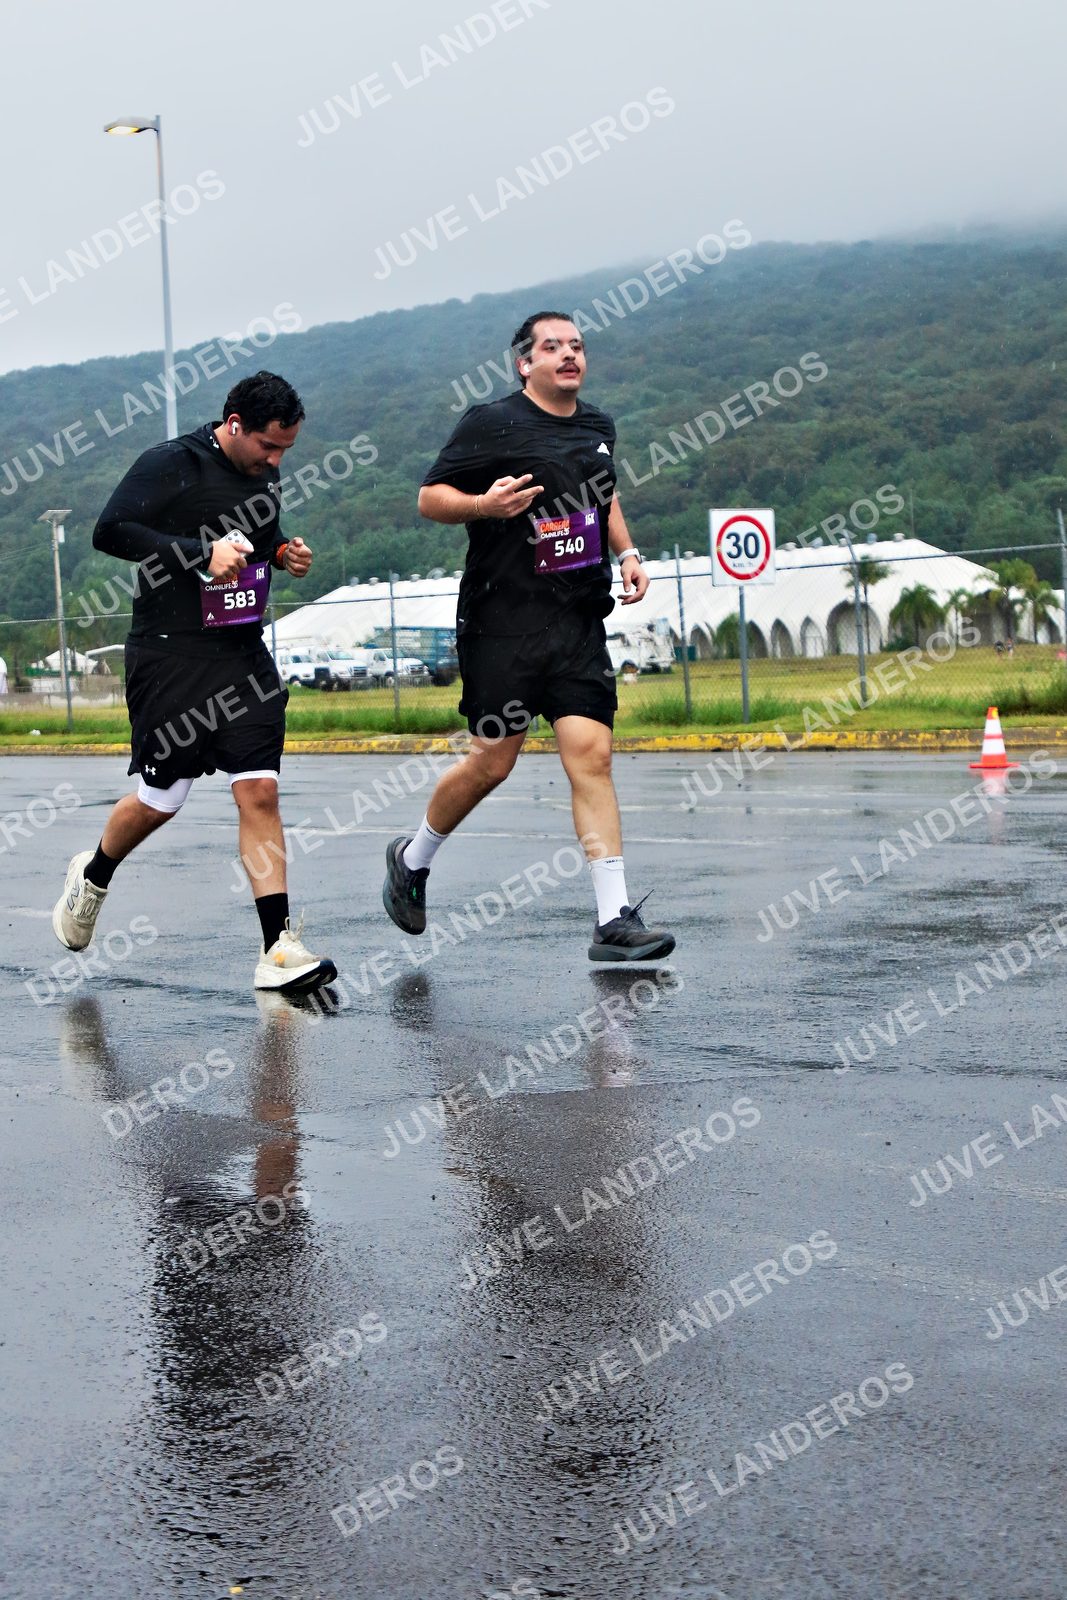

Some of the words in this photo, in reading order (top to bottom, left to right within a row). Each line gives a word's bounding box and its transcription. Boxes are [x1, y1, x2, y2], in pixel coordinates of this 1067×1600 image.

[554, 535, 585, 557] 540
[726, 532, 760, 559] 30
[205, 582, 231, 591] OMNILIFE
[223, 589, 257, 610] 583
